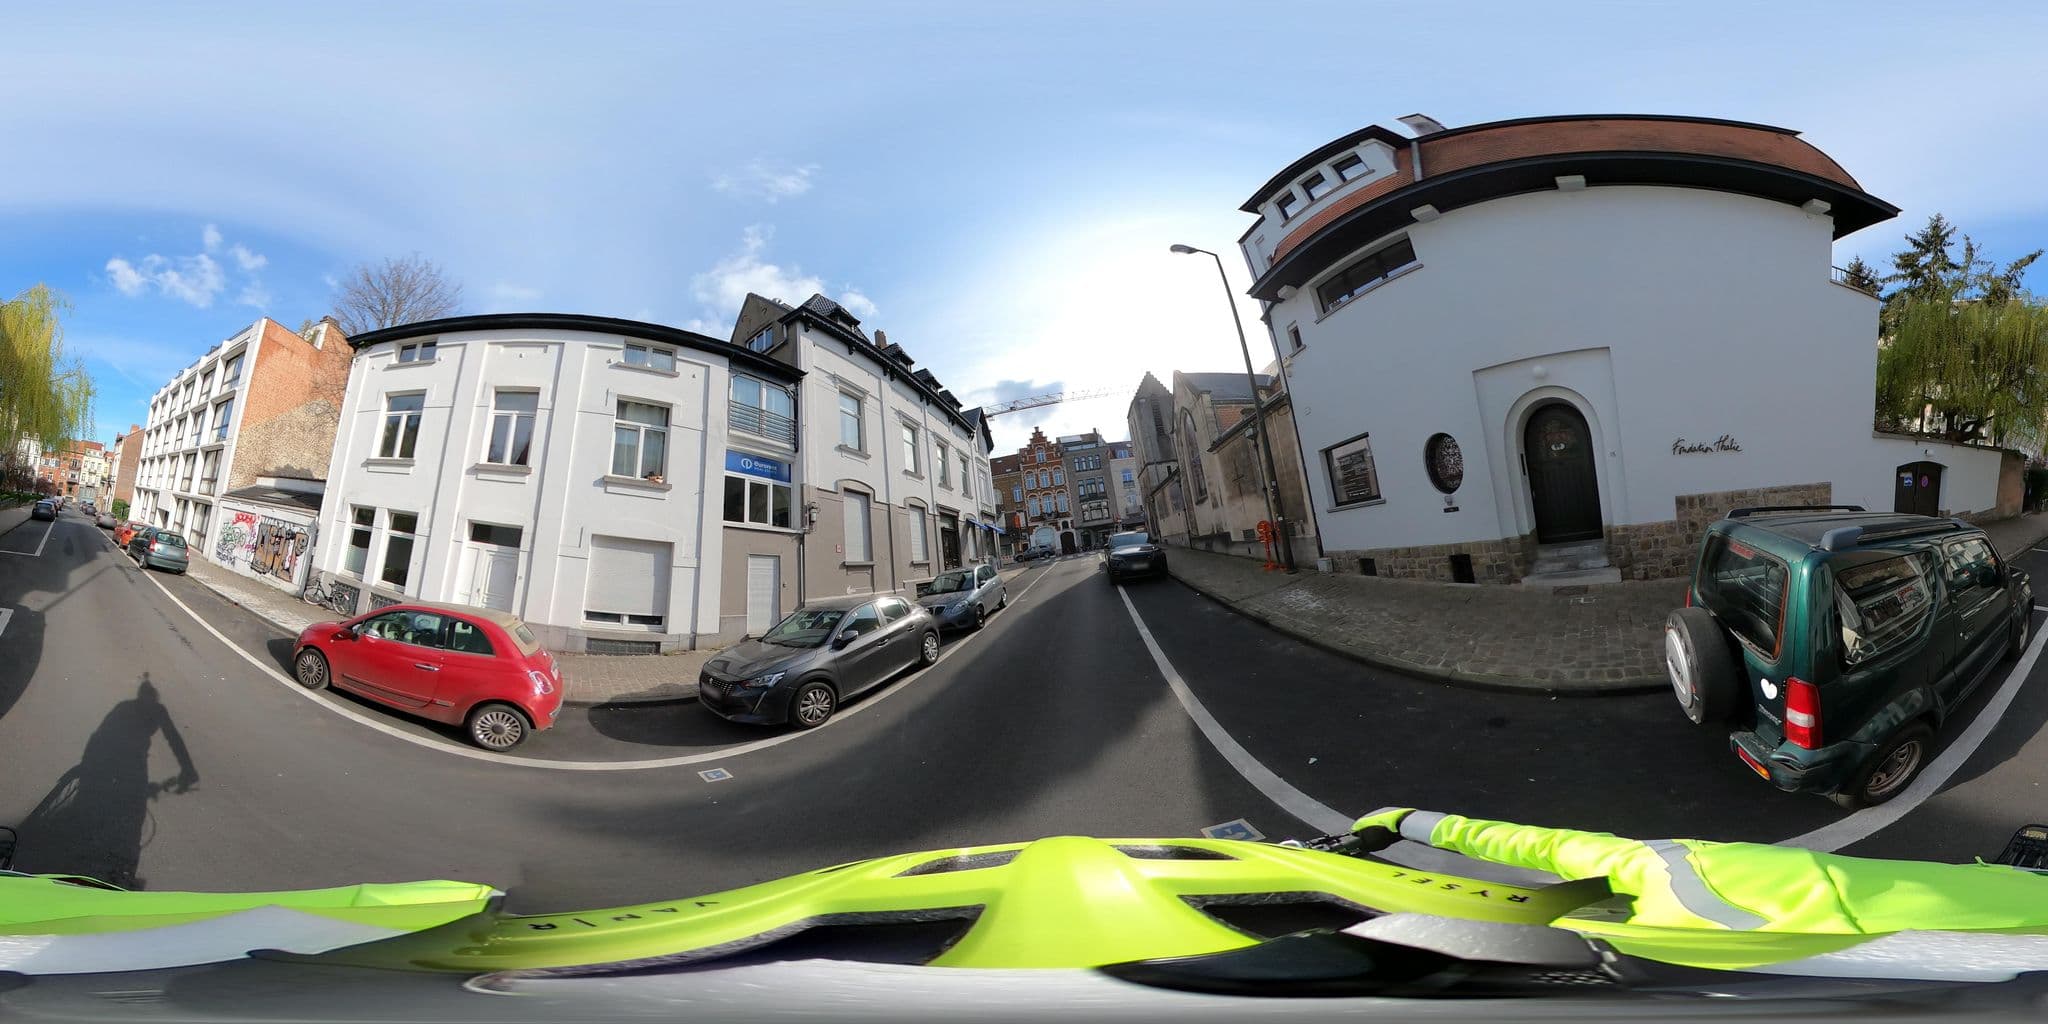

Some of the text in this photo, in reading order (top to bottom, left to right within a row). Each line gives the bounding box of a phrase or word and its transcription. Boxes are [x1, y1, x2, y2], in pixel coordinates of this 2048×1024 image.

[1672, 434, 1743, 455] Fondation Thalie
[1392, 871, 1528, 903] RYSEL
